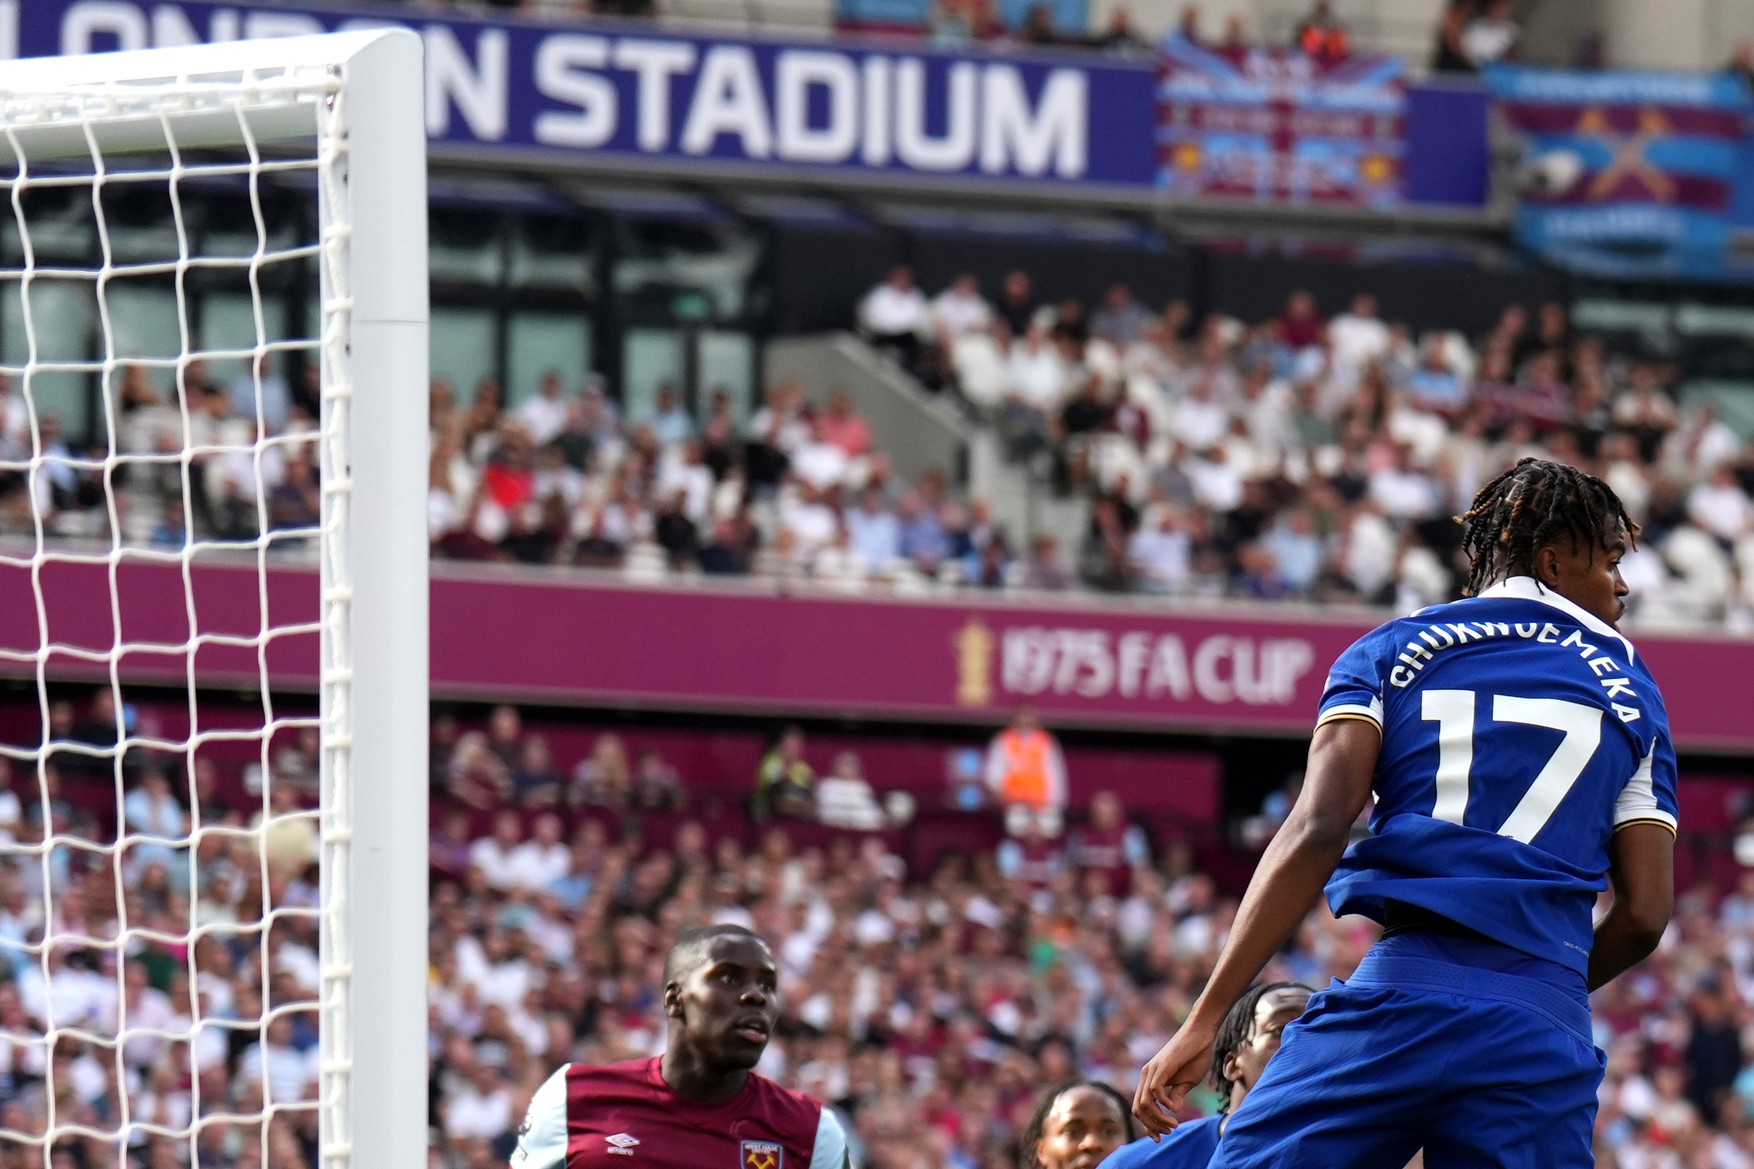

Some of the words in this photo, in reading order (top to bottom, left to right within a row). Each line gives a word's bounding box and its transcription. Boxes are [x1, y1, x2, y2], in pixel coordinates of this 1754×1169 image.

[534, 33, 1087, 178] STADIUM
[1002, 627, 1115, 698] 1975
[1118, 631, 1191, 700] FA
[1194, 634, 1314, 704] CUP
[1421, 690, 1604, 845] 17
